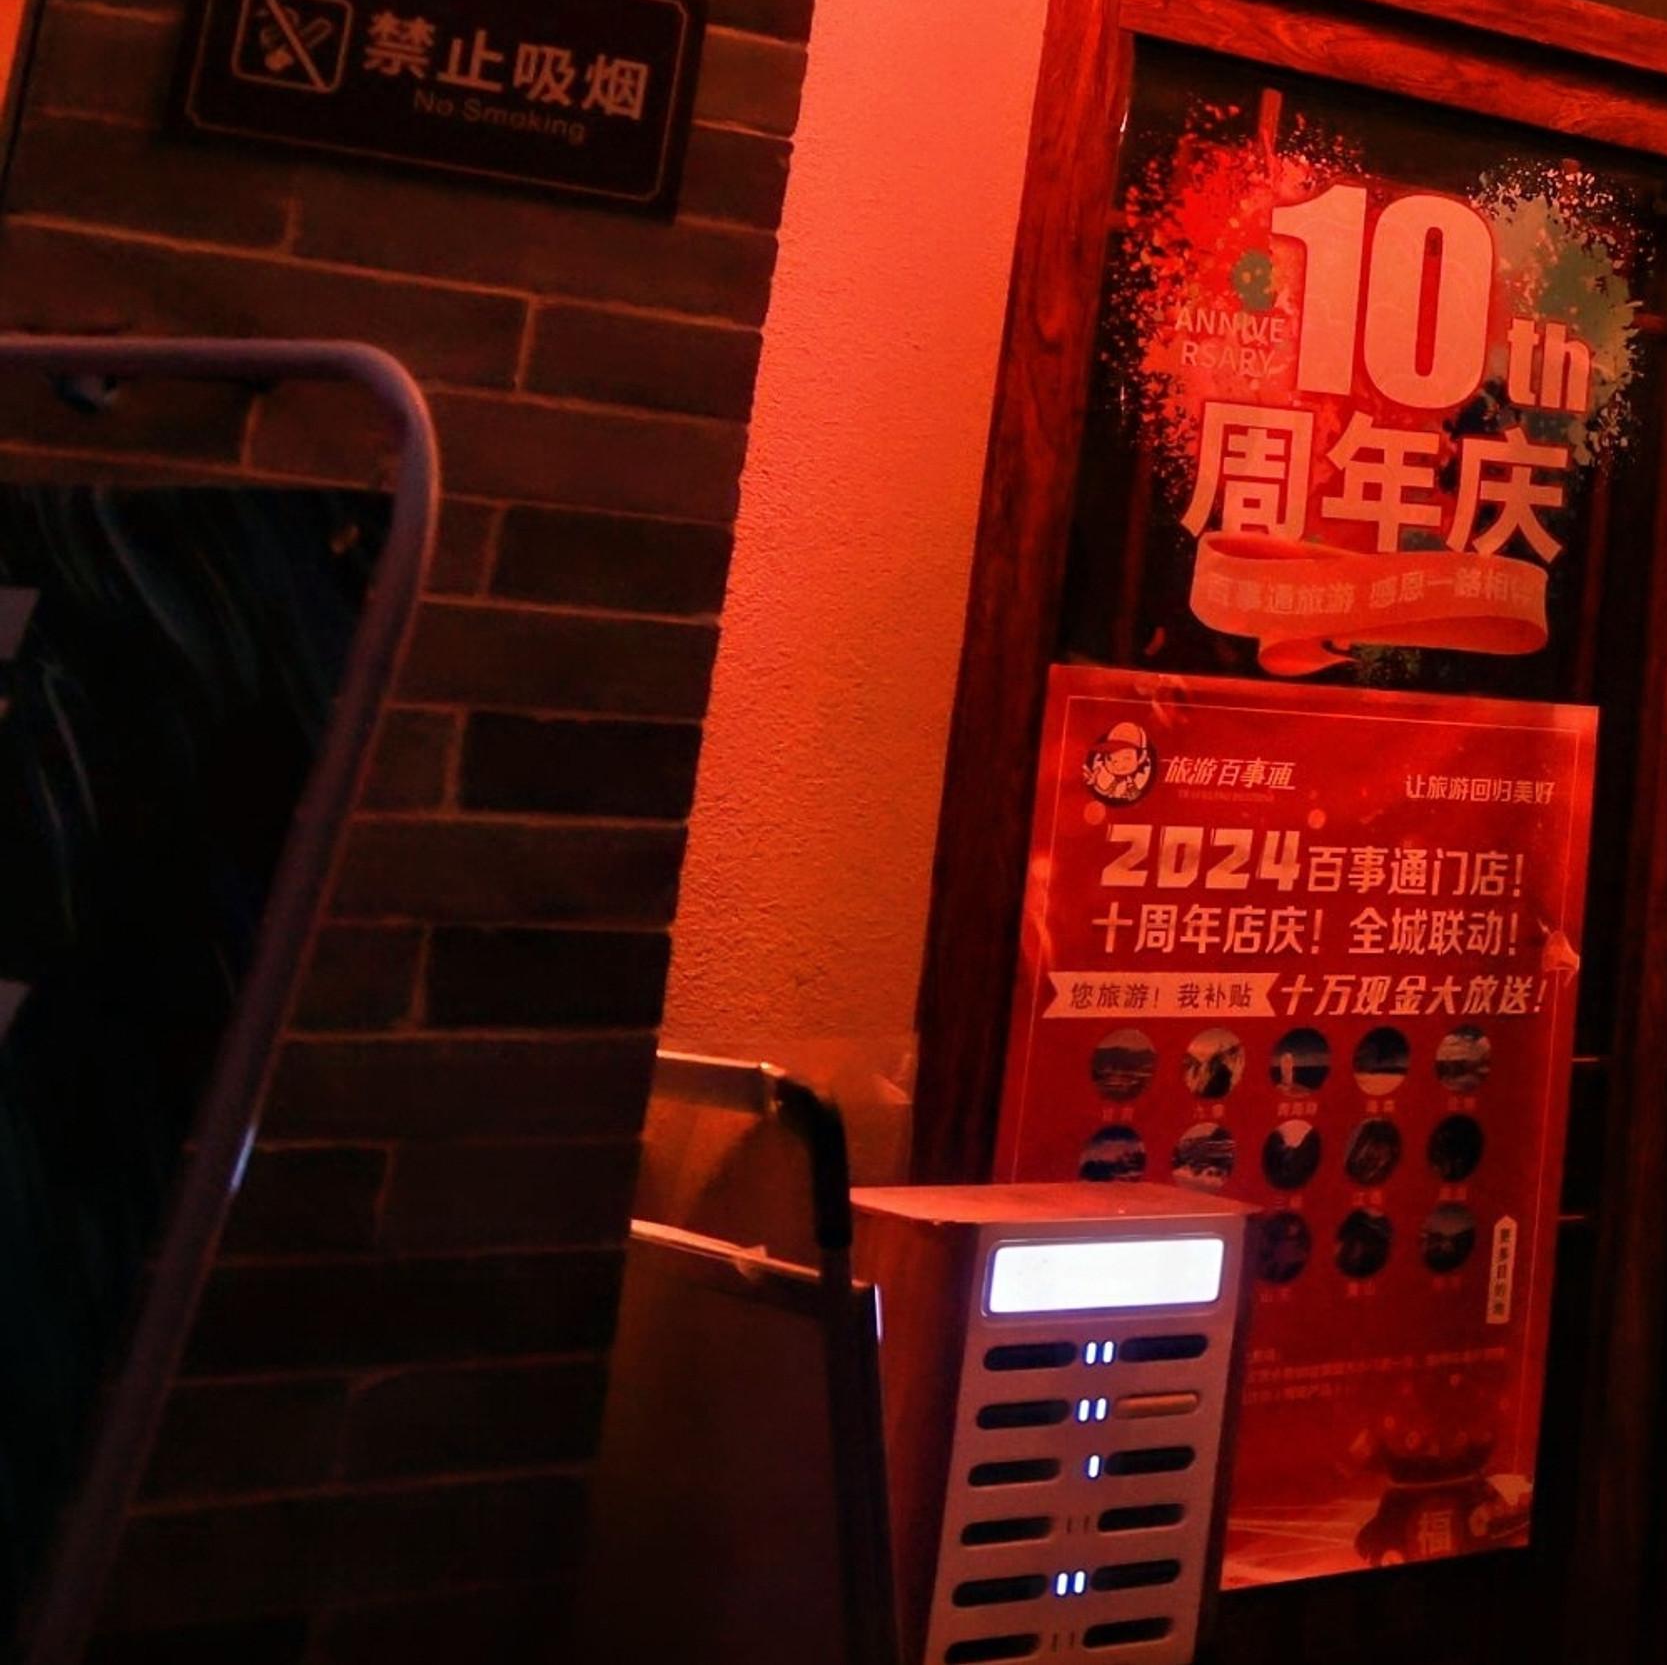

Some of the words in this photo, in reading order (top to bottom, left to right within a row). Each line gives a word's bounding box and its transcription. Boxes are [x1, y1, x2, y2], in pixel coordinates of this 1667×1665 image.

[361, 9, 650, 121] 禁止吸烟
[413, 89, 454, 117] No
[463, 97, 586, 146] Smoking
[1175, 307, 1286, 344] ANNIVE
[1181, 341, 1275, 375] RSARY
[1181, 402, 1569, 563] 周年庆
[1160, 756, 1296, 791] 旅游百事通
[1405, 773, 1555, 806] 让旅游回归美好
[1091, 904, 1323, 956] 十周年店庆！
[1348, 907, 1519, 957] 全城联动！
[1280, 974, 1547, 1017] 十万现金大放送！
